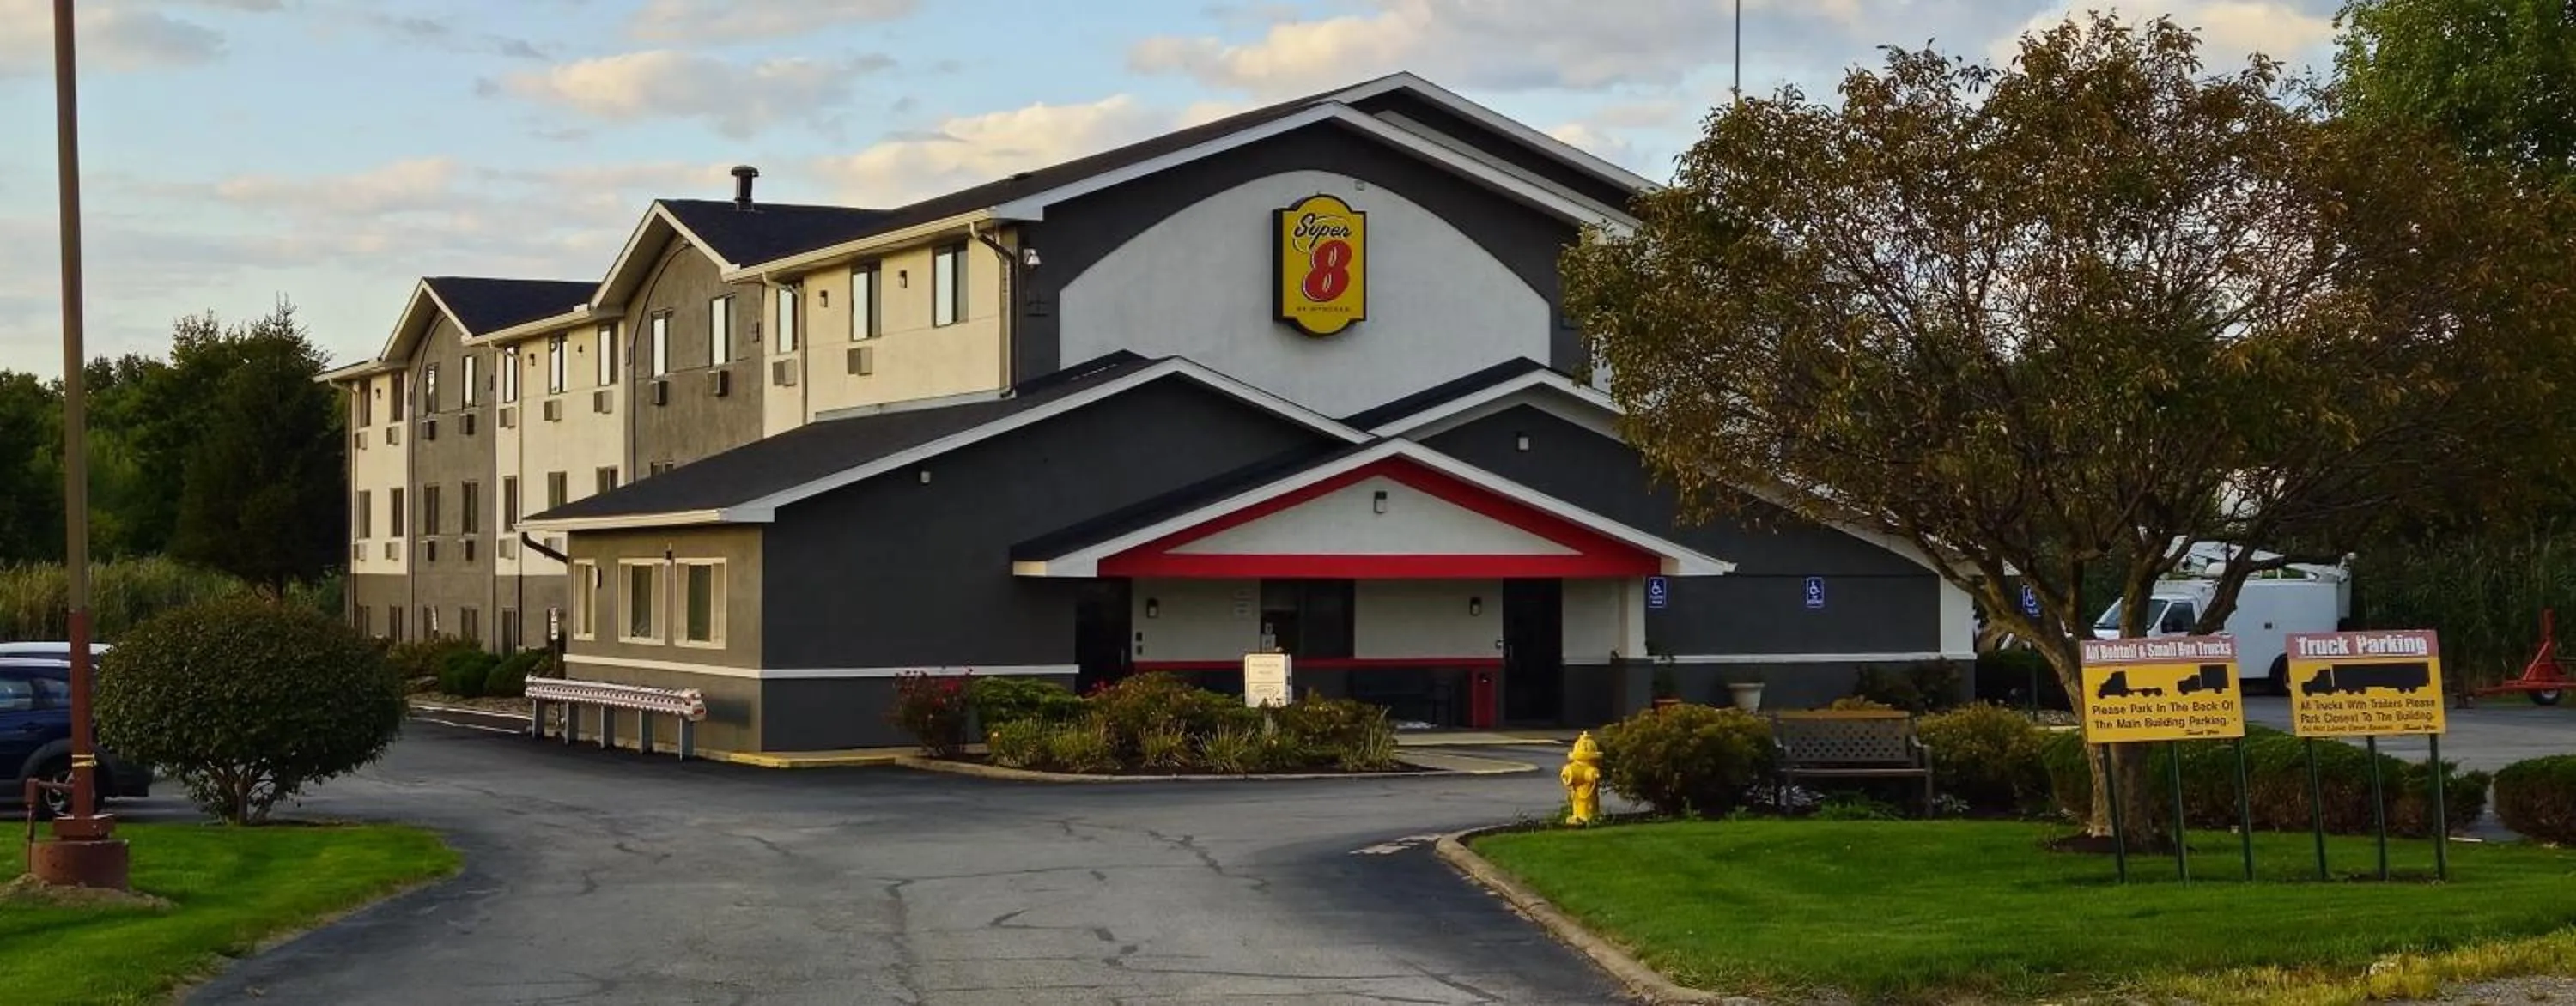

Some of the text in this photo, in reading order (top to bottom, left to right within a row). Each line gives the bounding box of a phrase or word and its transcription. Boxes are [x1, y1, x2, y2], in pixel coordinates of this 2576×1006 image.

[1293, 213, 1352, 251] Super
[1302, 240, 1352, 302] 8
[2086, 645, 2099, 660] All
[2100, 644, 2137, 659] Bobtail
[2148, 642, 2176, 658] Small
[2178, 641, 2196, 657] Box
[2197, 640, 2232, 656] Trucks
[2296, 634, 2428, 655] Truck Parking
[2092, 700, 2234, 715] Please Park In The Back Of
[2315, 700, 2343, 711] Trucks
[2347, 700, 2367, 710] With
[2370, 698, 2403, 708] Trailers
[2406, 698, 2435, 708] Please
[2095, 719, 2113, 729] The
[2117, 718, 2141, 729] Main
[2144, 717, 2185, 728] Building
[2300, 713, 2319, 723] Park
[2324, 712, 2359, 723] Closest
[2363, 712, 2372, 722] To
[2376, 712, 2393, 722] The
